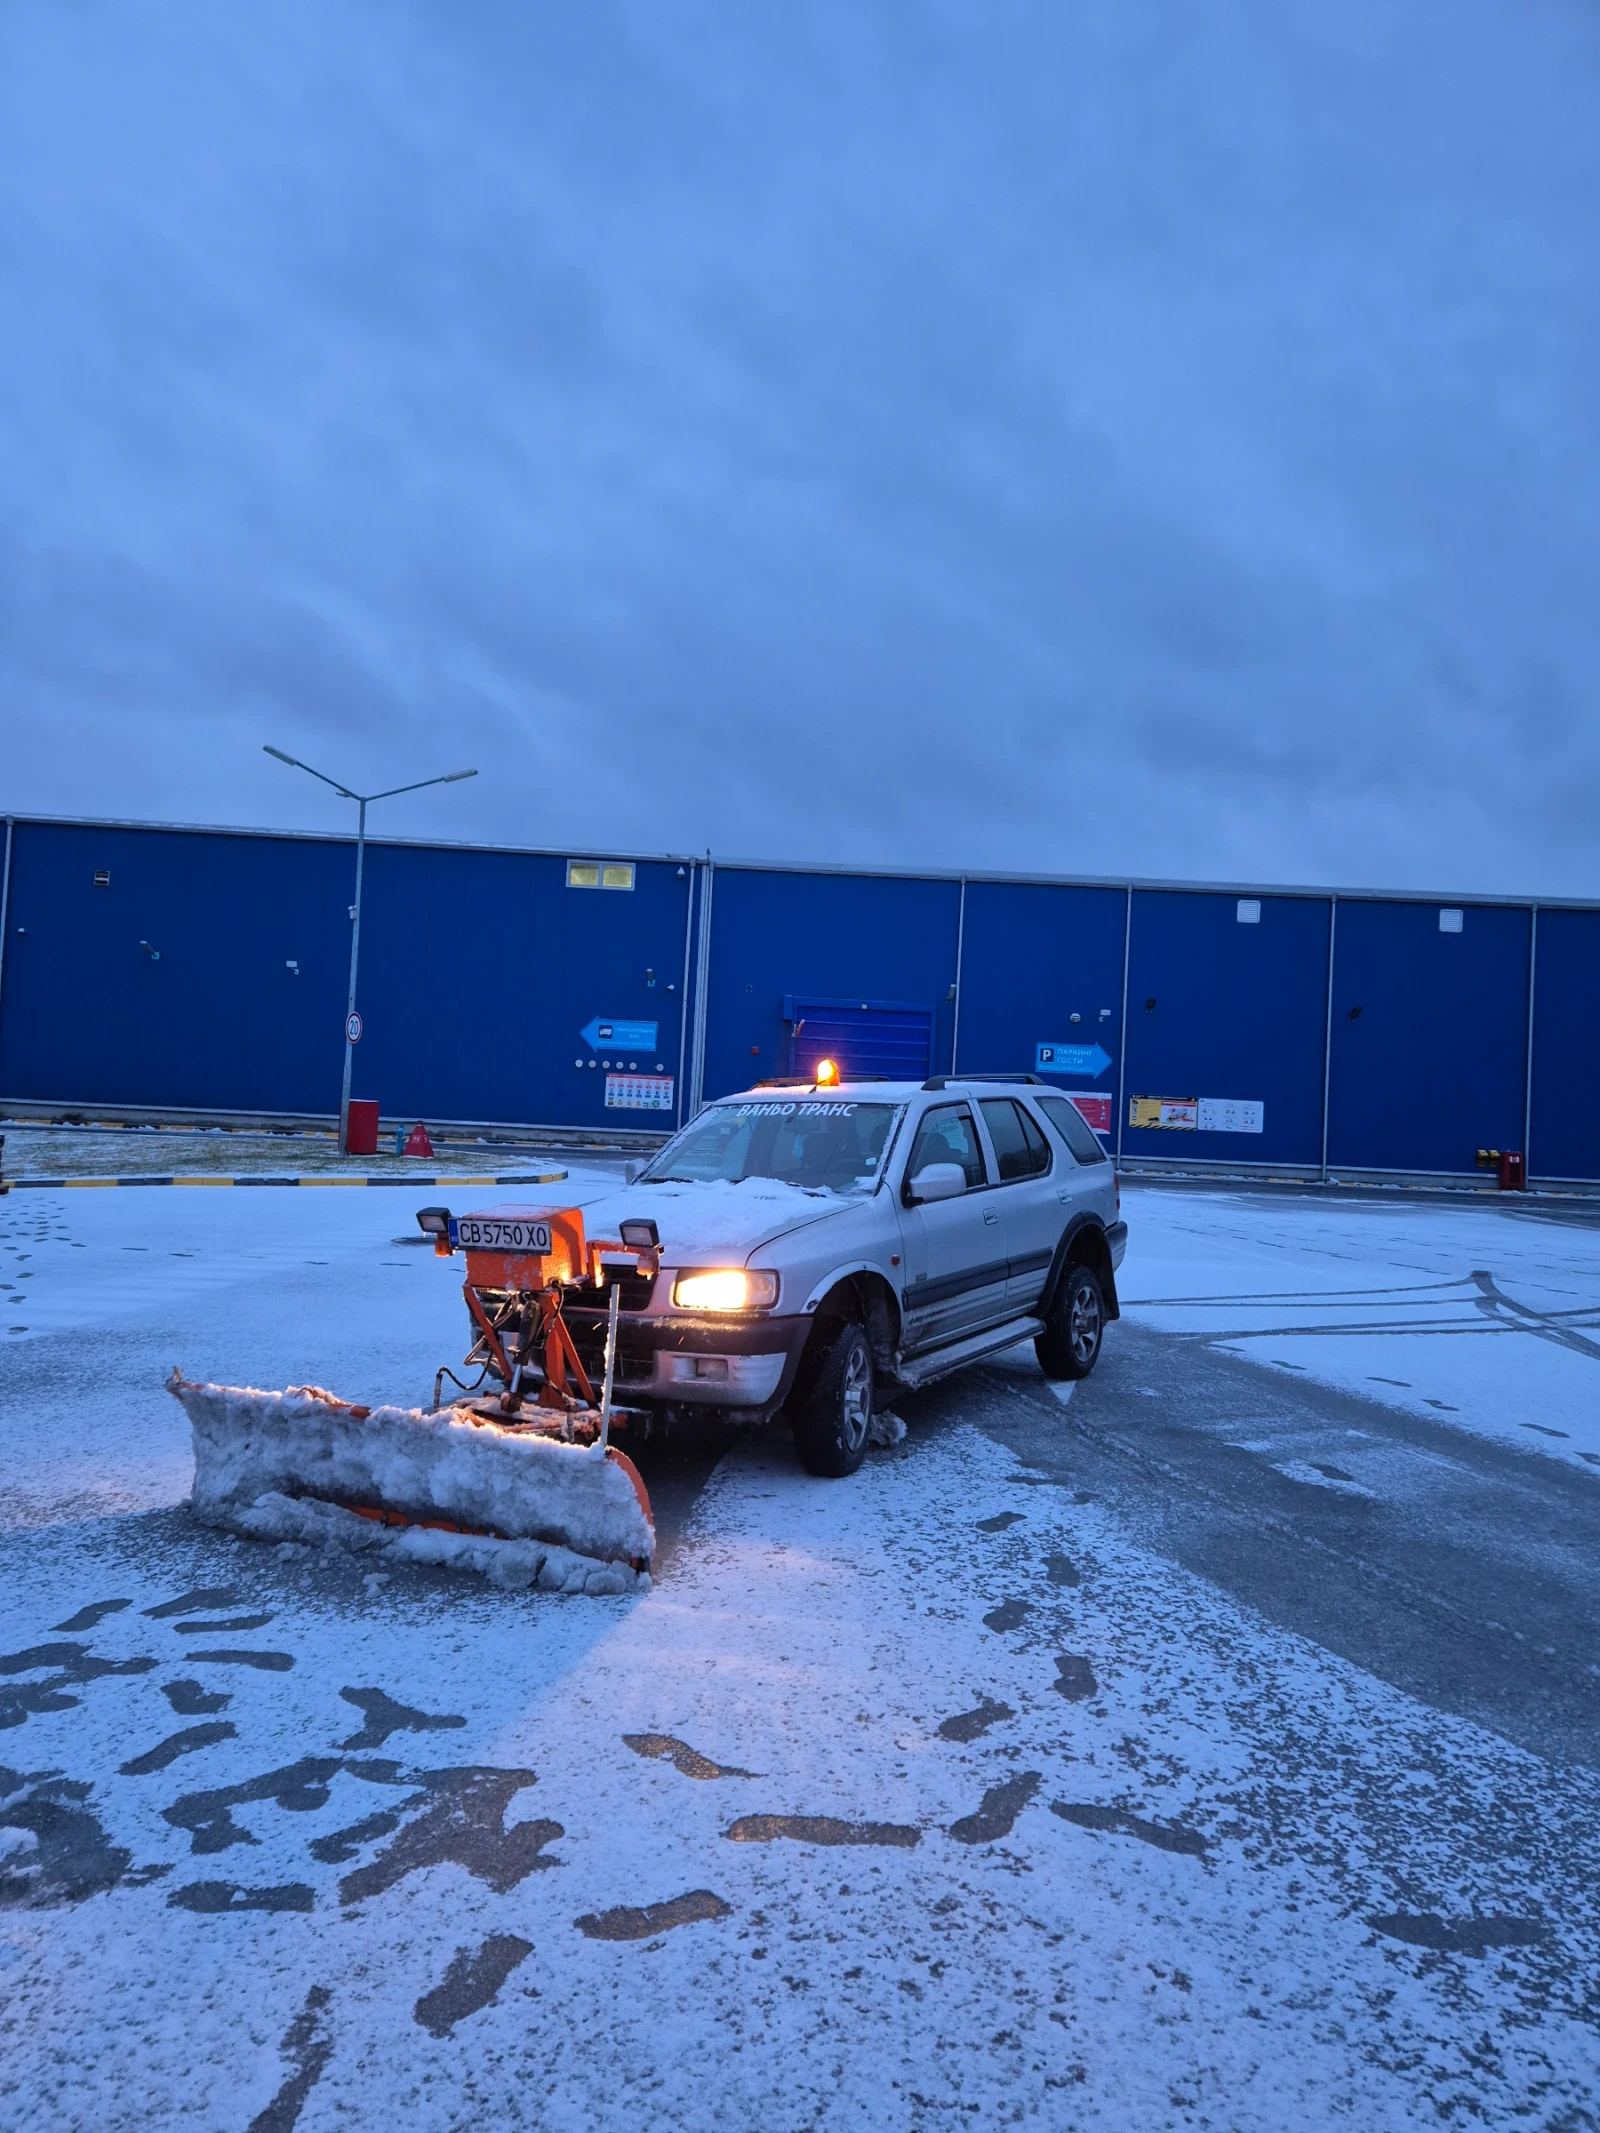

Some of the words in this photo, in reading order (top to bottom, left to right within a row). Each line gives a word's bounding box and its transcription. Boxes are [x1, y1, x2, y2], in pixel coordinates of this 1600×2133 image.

[350, 1020, 359, 1035] 20
[1042, 1049, 1052, 1061] P
[1057, 1048, 1092, 1056] ПАРКИНГ
[736, 1103, 796, 1117] ВАНЬО
[798, 1103, 858, 1117] ТРАНС
